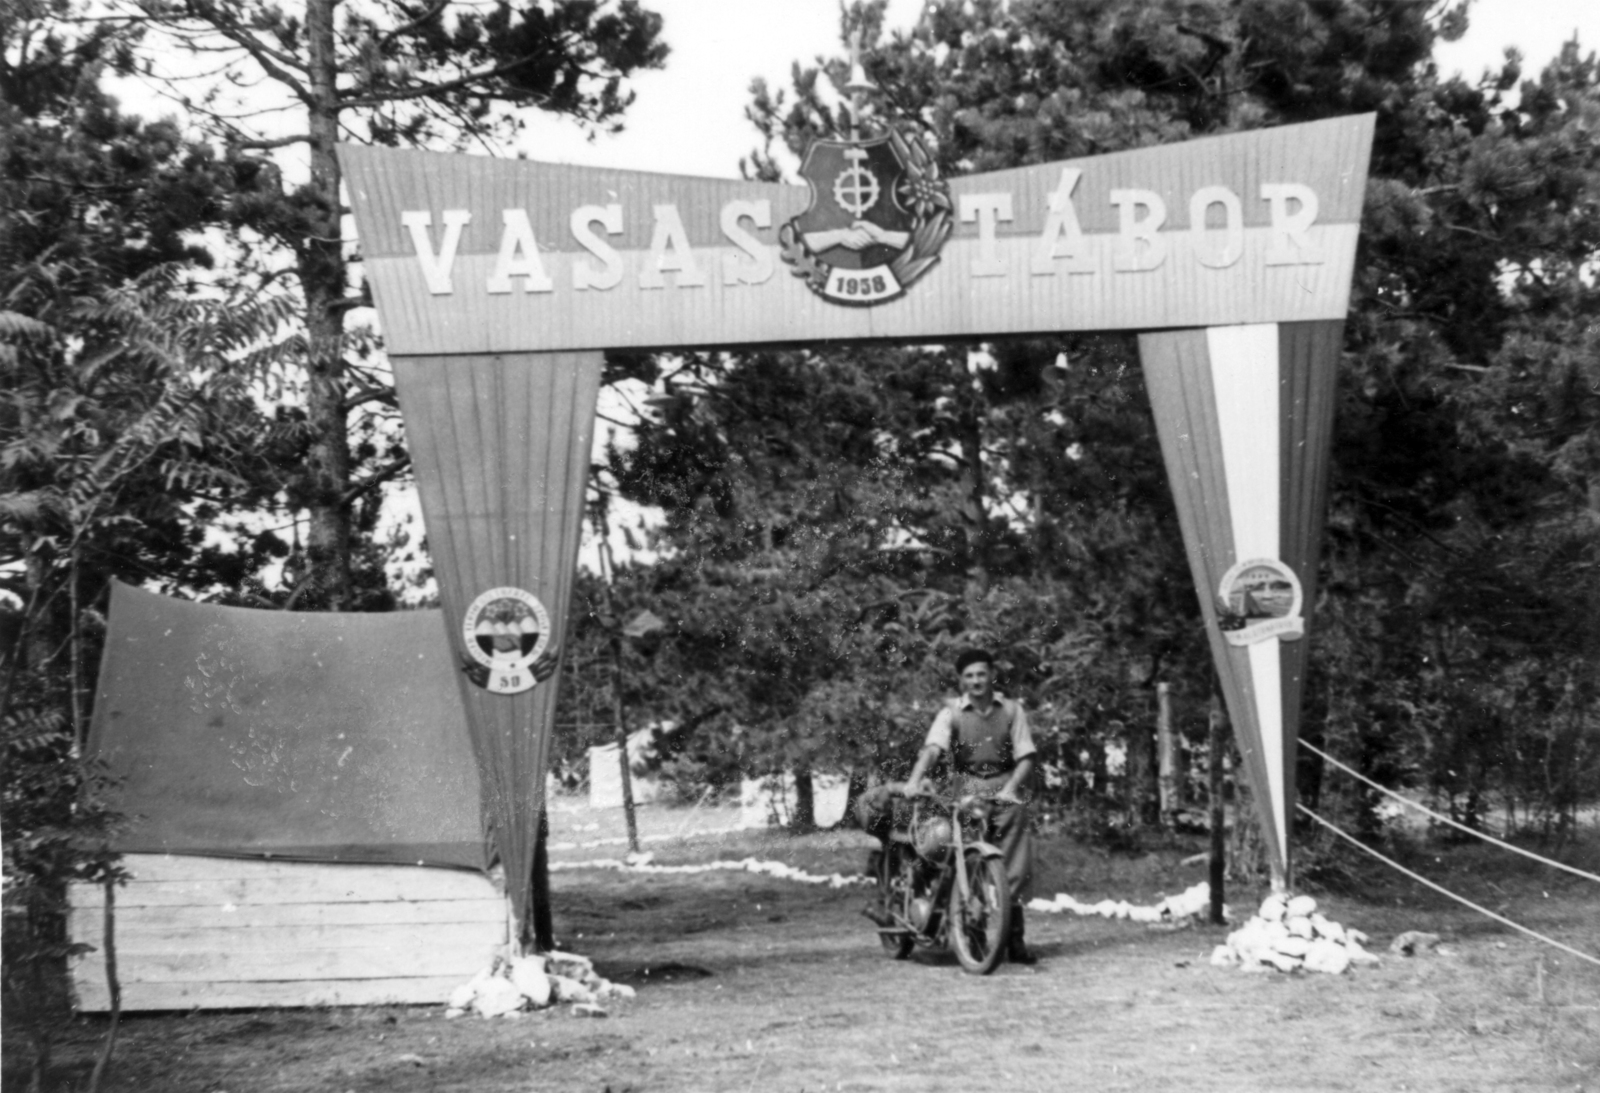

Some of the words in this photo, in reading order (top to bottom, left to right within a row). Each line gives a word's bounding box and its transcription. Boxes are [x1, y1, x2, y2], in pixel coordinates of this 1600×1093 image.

[401, 199, 773, 296] VASAS
[959, 168, 1324, 277] TÁBOR
[835, 275, 887, 295] 1958
